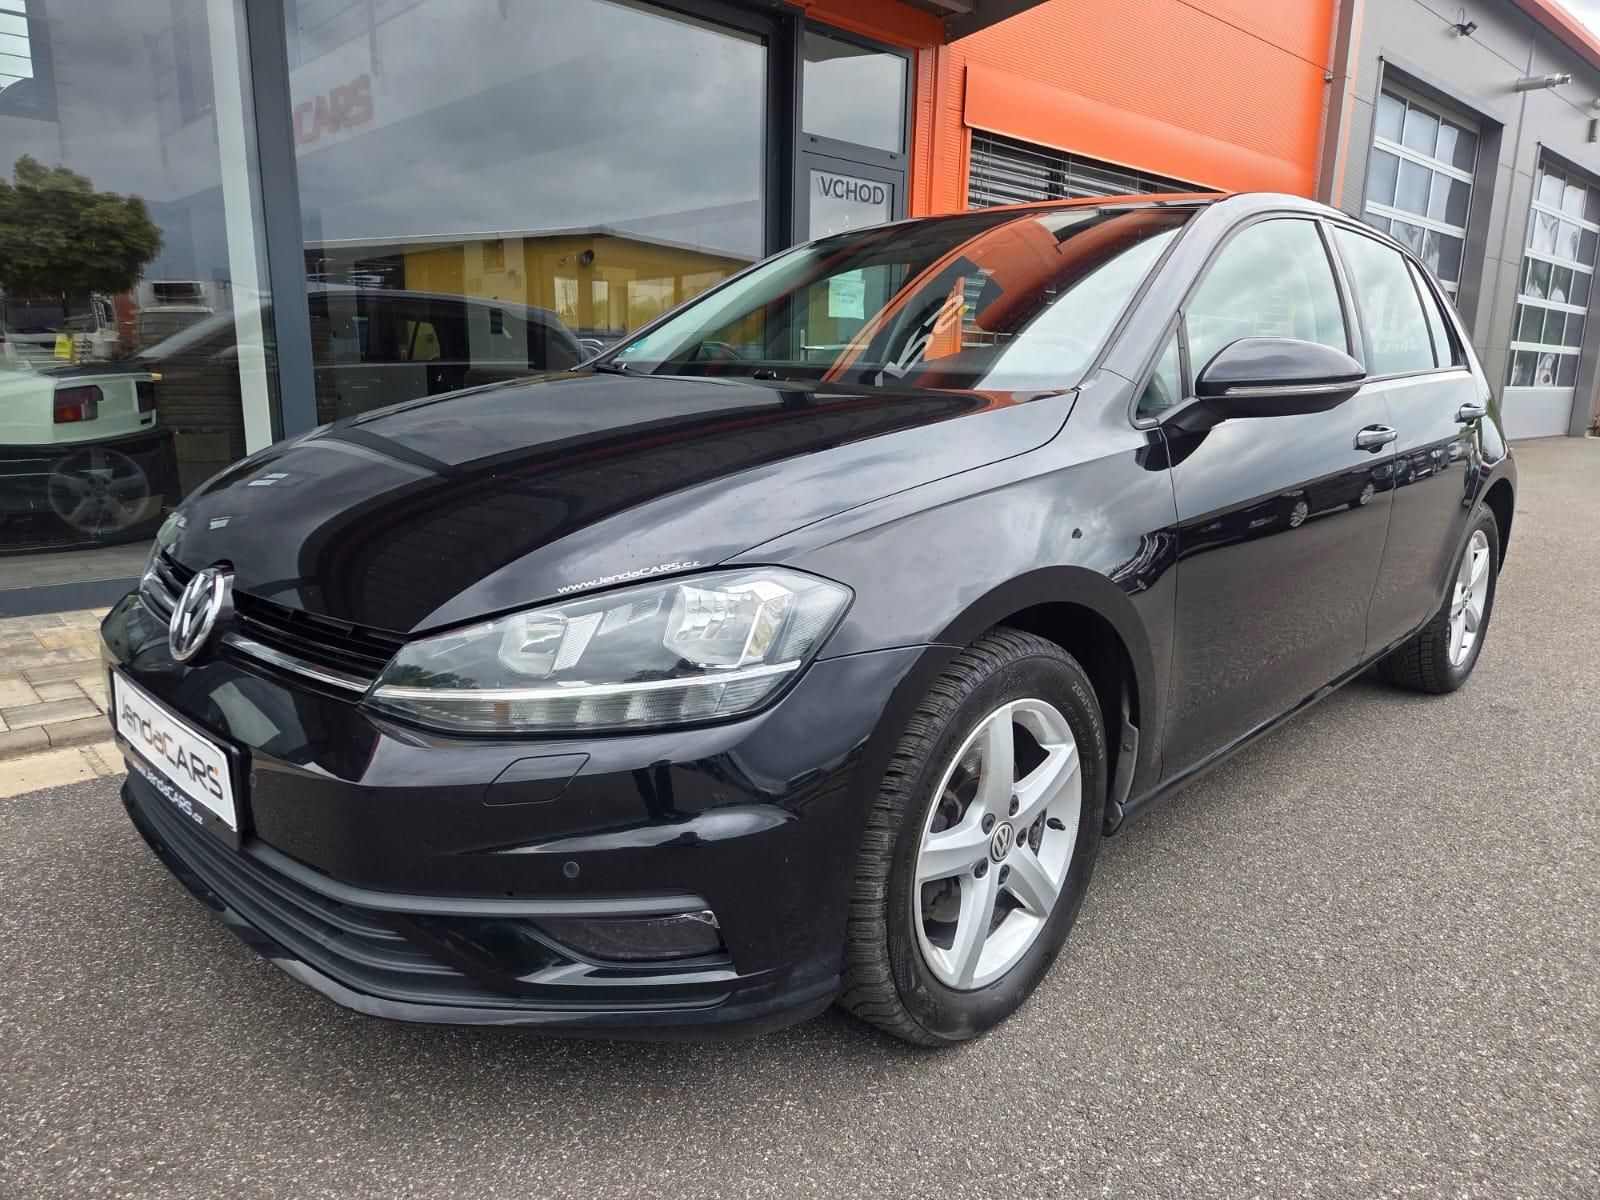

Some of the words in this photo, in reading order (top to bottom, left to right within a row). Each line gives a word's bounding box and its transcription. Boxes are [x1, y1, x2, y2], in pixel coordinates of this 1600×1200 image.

[821, 175, 885, 205] VCHOD
[556, 560, 702, 595] www.JendaCARS.cz
[121, 694, 224, 801] JendaCARS
